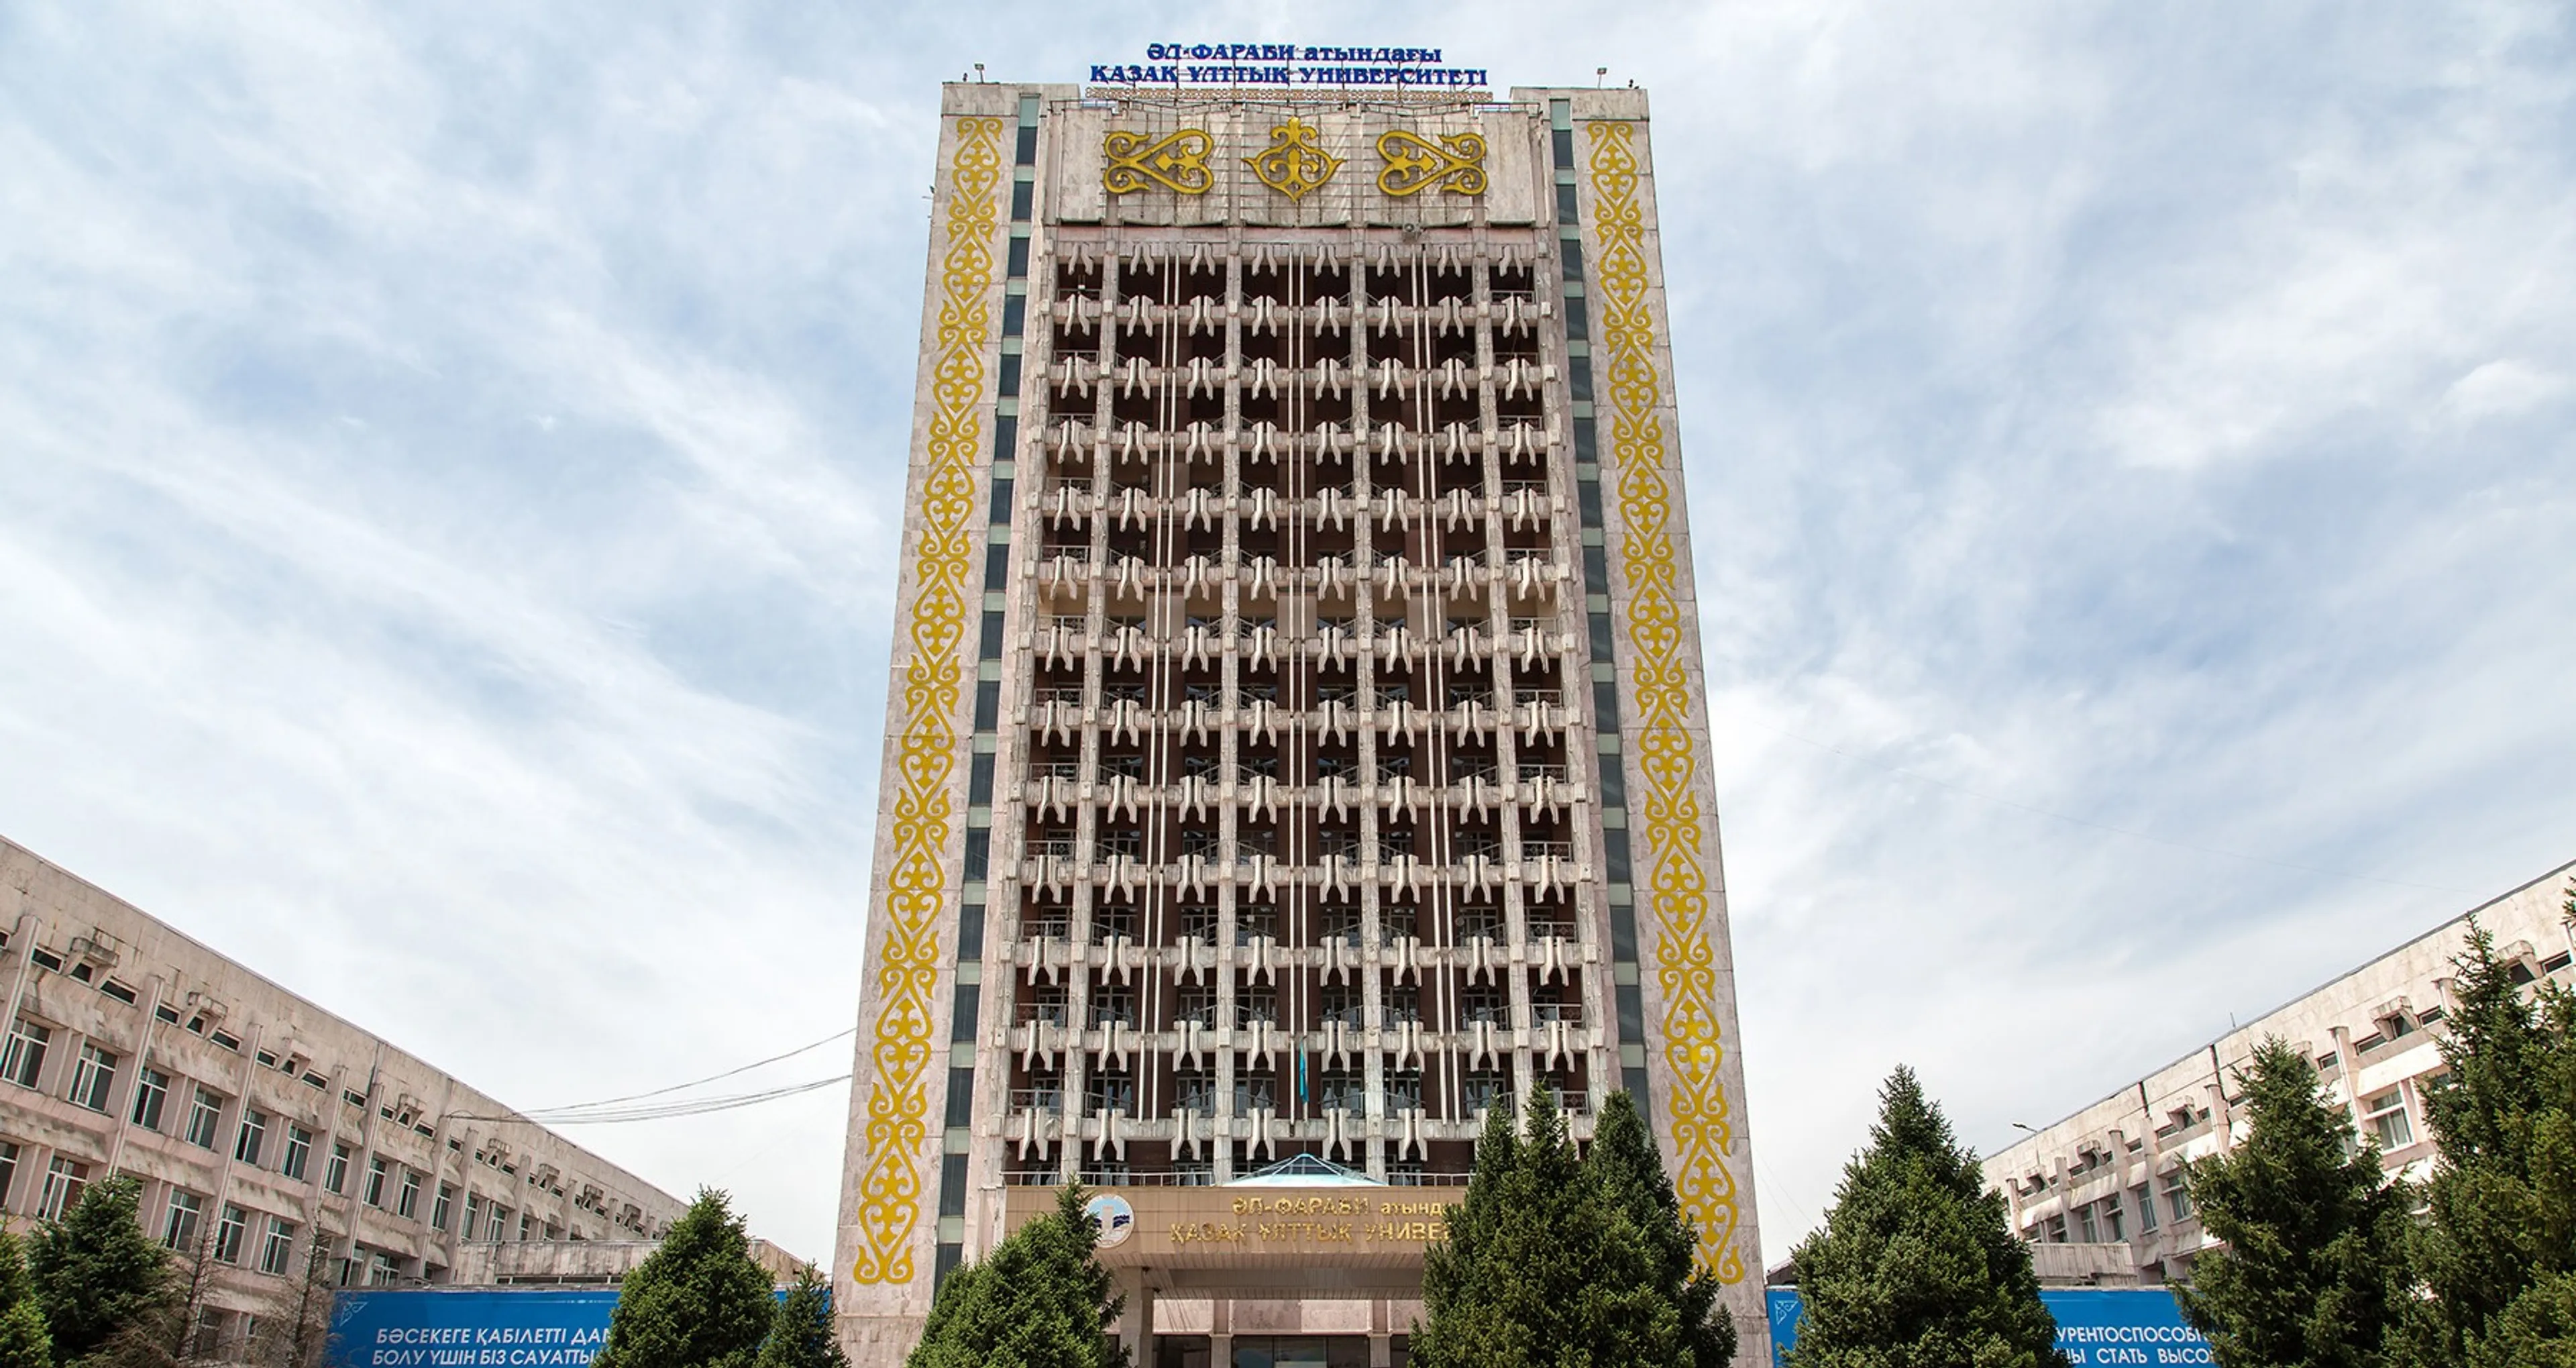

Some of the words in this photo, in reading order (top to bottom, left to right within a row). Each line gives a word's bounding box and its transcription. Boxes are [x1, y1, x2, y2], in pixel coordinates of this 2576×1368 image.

[1147, 43, 1295, 60] ӘЛ-ФАРАБИ
[1304, 47, 1442, 64] атындағы
[1299, 68, 1487, 85] УНИВЕРСИТЕТІ
[1233, 1198, 1369, 1215] ӘЛ-ФАРАБИ
[376, 1328, 472, 1344] БӘСЕКЕГЕ
[476, 1328, 567, 1346] ҚАБІЛЕТТІ
[372, 1349, 426, 1365] БОЛУ
[429, 1349, 476, 1365] ҮШІН
[480, 1349, 506, 1365] БІЗ
[2096, 1348, 2148, 1364] СТАТЬ
[2157, 1348, 2214, 1364] ВЫСО
